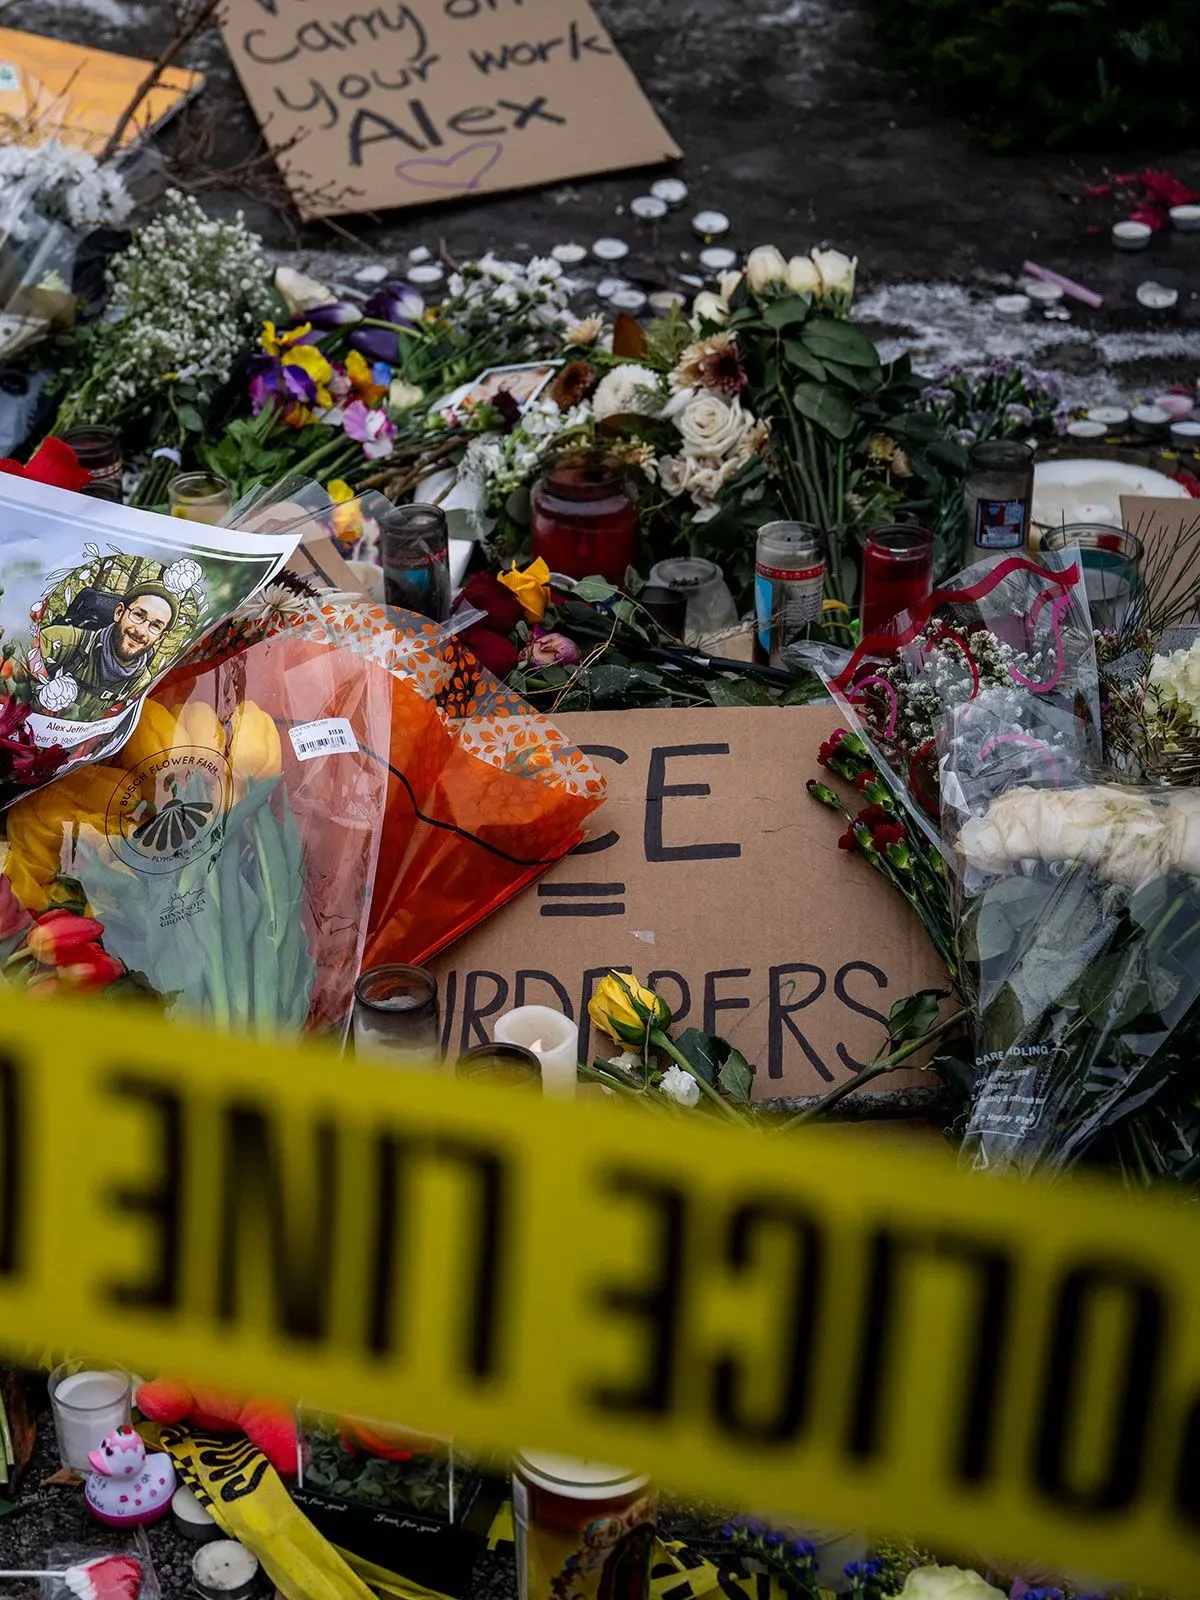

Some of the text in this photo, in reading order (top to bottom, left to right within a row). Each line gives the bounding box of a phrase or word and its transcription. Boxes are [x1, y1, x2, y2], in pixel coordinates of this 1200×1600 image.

[243, 5, 428, 64] Carry
[274, 22, 613, 128] your work
[349, 96, 566, 167] Alex
[46, 721, 64, 732] Alex
[120, 772, 148, 807] BUSCH
[149, 756, 196, 775] FLOWER
[975, 1051, 1004, 1066] CARE
[97, 1065, 508, 1390] LINE
[585, 1150, 1200, 1545] OLICE
